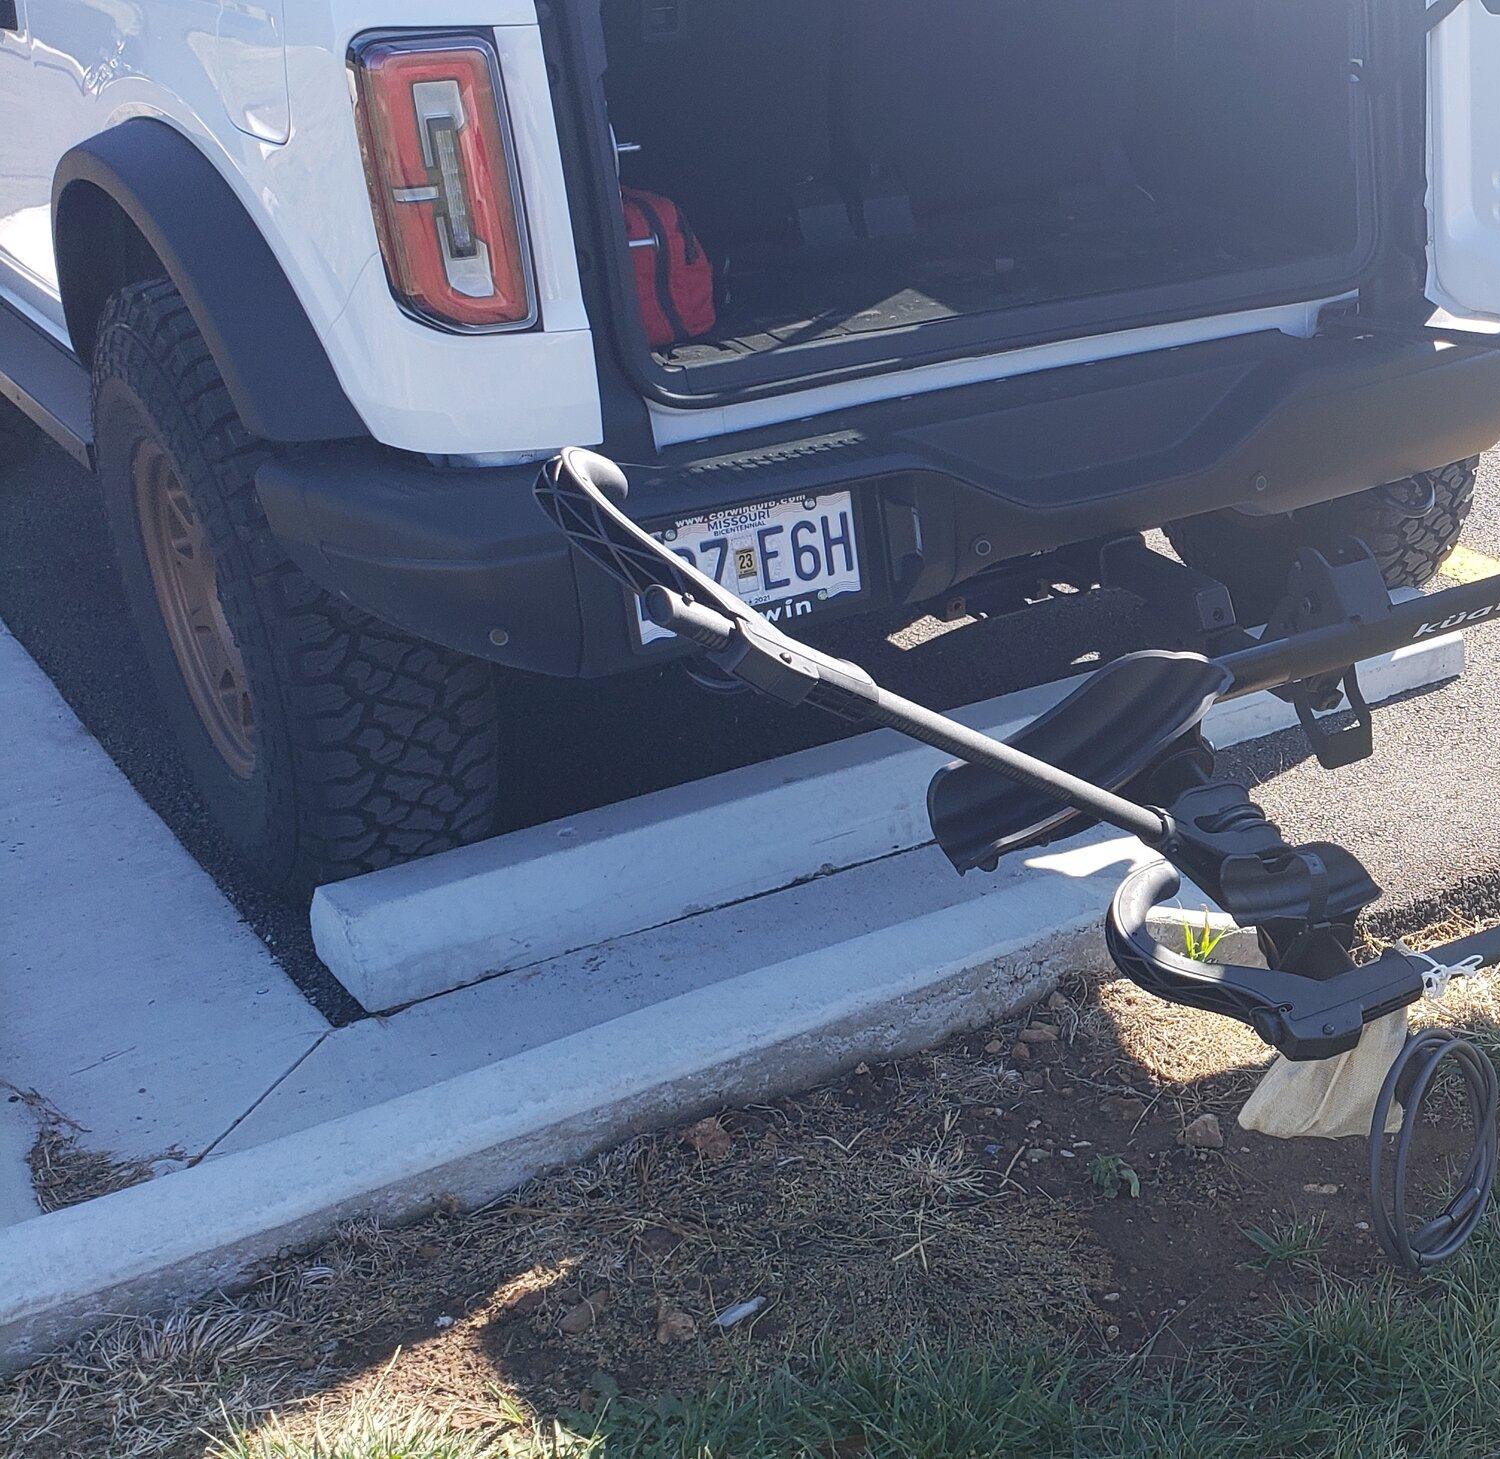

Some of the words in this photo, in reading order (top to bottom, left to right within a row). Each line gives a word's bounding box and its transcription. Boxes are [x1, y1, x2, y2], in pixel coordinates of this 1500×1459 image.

[707, 509, 771, 532] MISSOURI
[713, 520, 767, 537] BICENTENNIAL
[757, 511, 854, 591] E6H
[738, 553, 754, 570] 23
[754, 594, 771, 604] 2021
